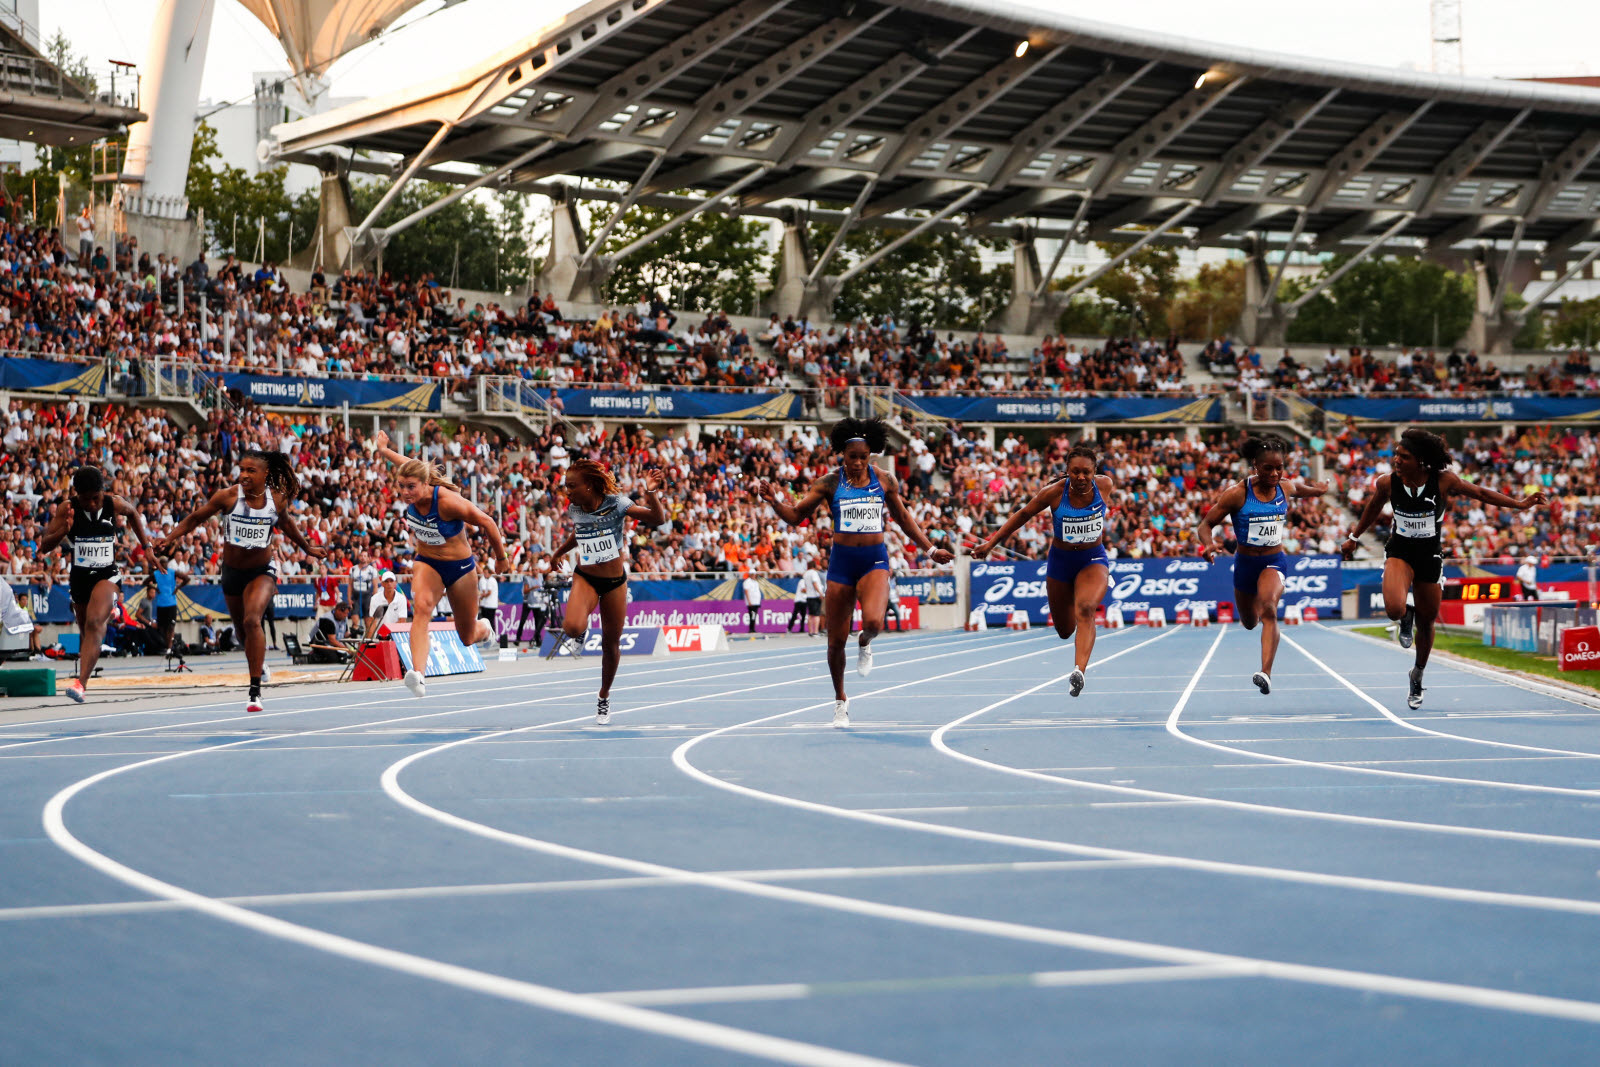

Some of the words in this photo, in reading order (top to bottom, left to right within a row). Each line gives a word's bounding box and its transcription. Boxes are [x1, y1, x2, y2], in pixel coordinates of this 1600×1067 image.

[250, 382, 287, 396] MEETING
[297, 380, 325, 404] PARIS
[590, 396, 631, 408] MEETING
[642, 393, 674, 415] PARIS
[997, 403, 1041, 414] MEETING
[1420, 404, 1466, 415] MEETING
[843, 507, 879, 519] THOMPSON
[1064, 521, 1102, 535] DANIELS
[1403, 520, 1426, 530] SMITH
[235, 525, 265, 539] HOBBS
[78, 546, 110, 557] WHYTE
[581, 542, 593, 554] TA
[593, 539, 613, 552] LOU
[1115, 562, 1144, 573] asics
[1180, 561, 1209, 572] asics
[1309, 558, 1338, 569] asics
[986, 565, 1015, 575] asics
[1012, 581, 1048, 598] asi
[1140, 578, 1199, 595] asics
[1284, 575, 1328, 593] sics
[1462, 583, 1501, 600] 10.9
[306, 594, 314, 607] DE
[1121, 601, 1150, 611] asics
[1310, 597, 1339, 608] asics
[632, 609, 665, 626] clubs
[667, 609, 684, 626] de
[686, 611, 740, 627] vacances
[665, 629, 700, 648] AIF
[1565, 651, 1600, 662] OMEGA
